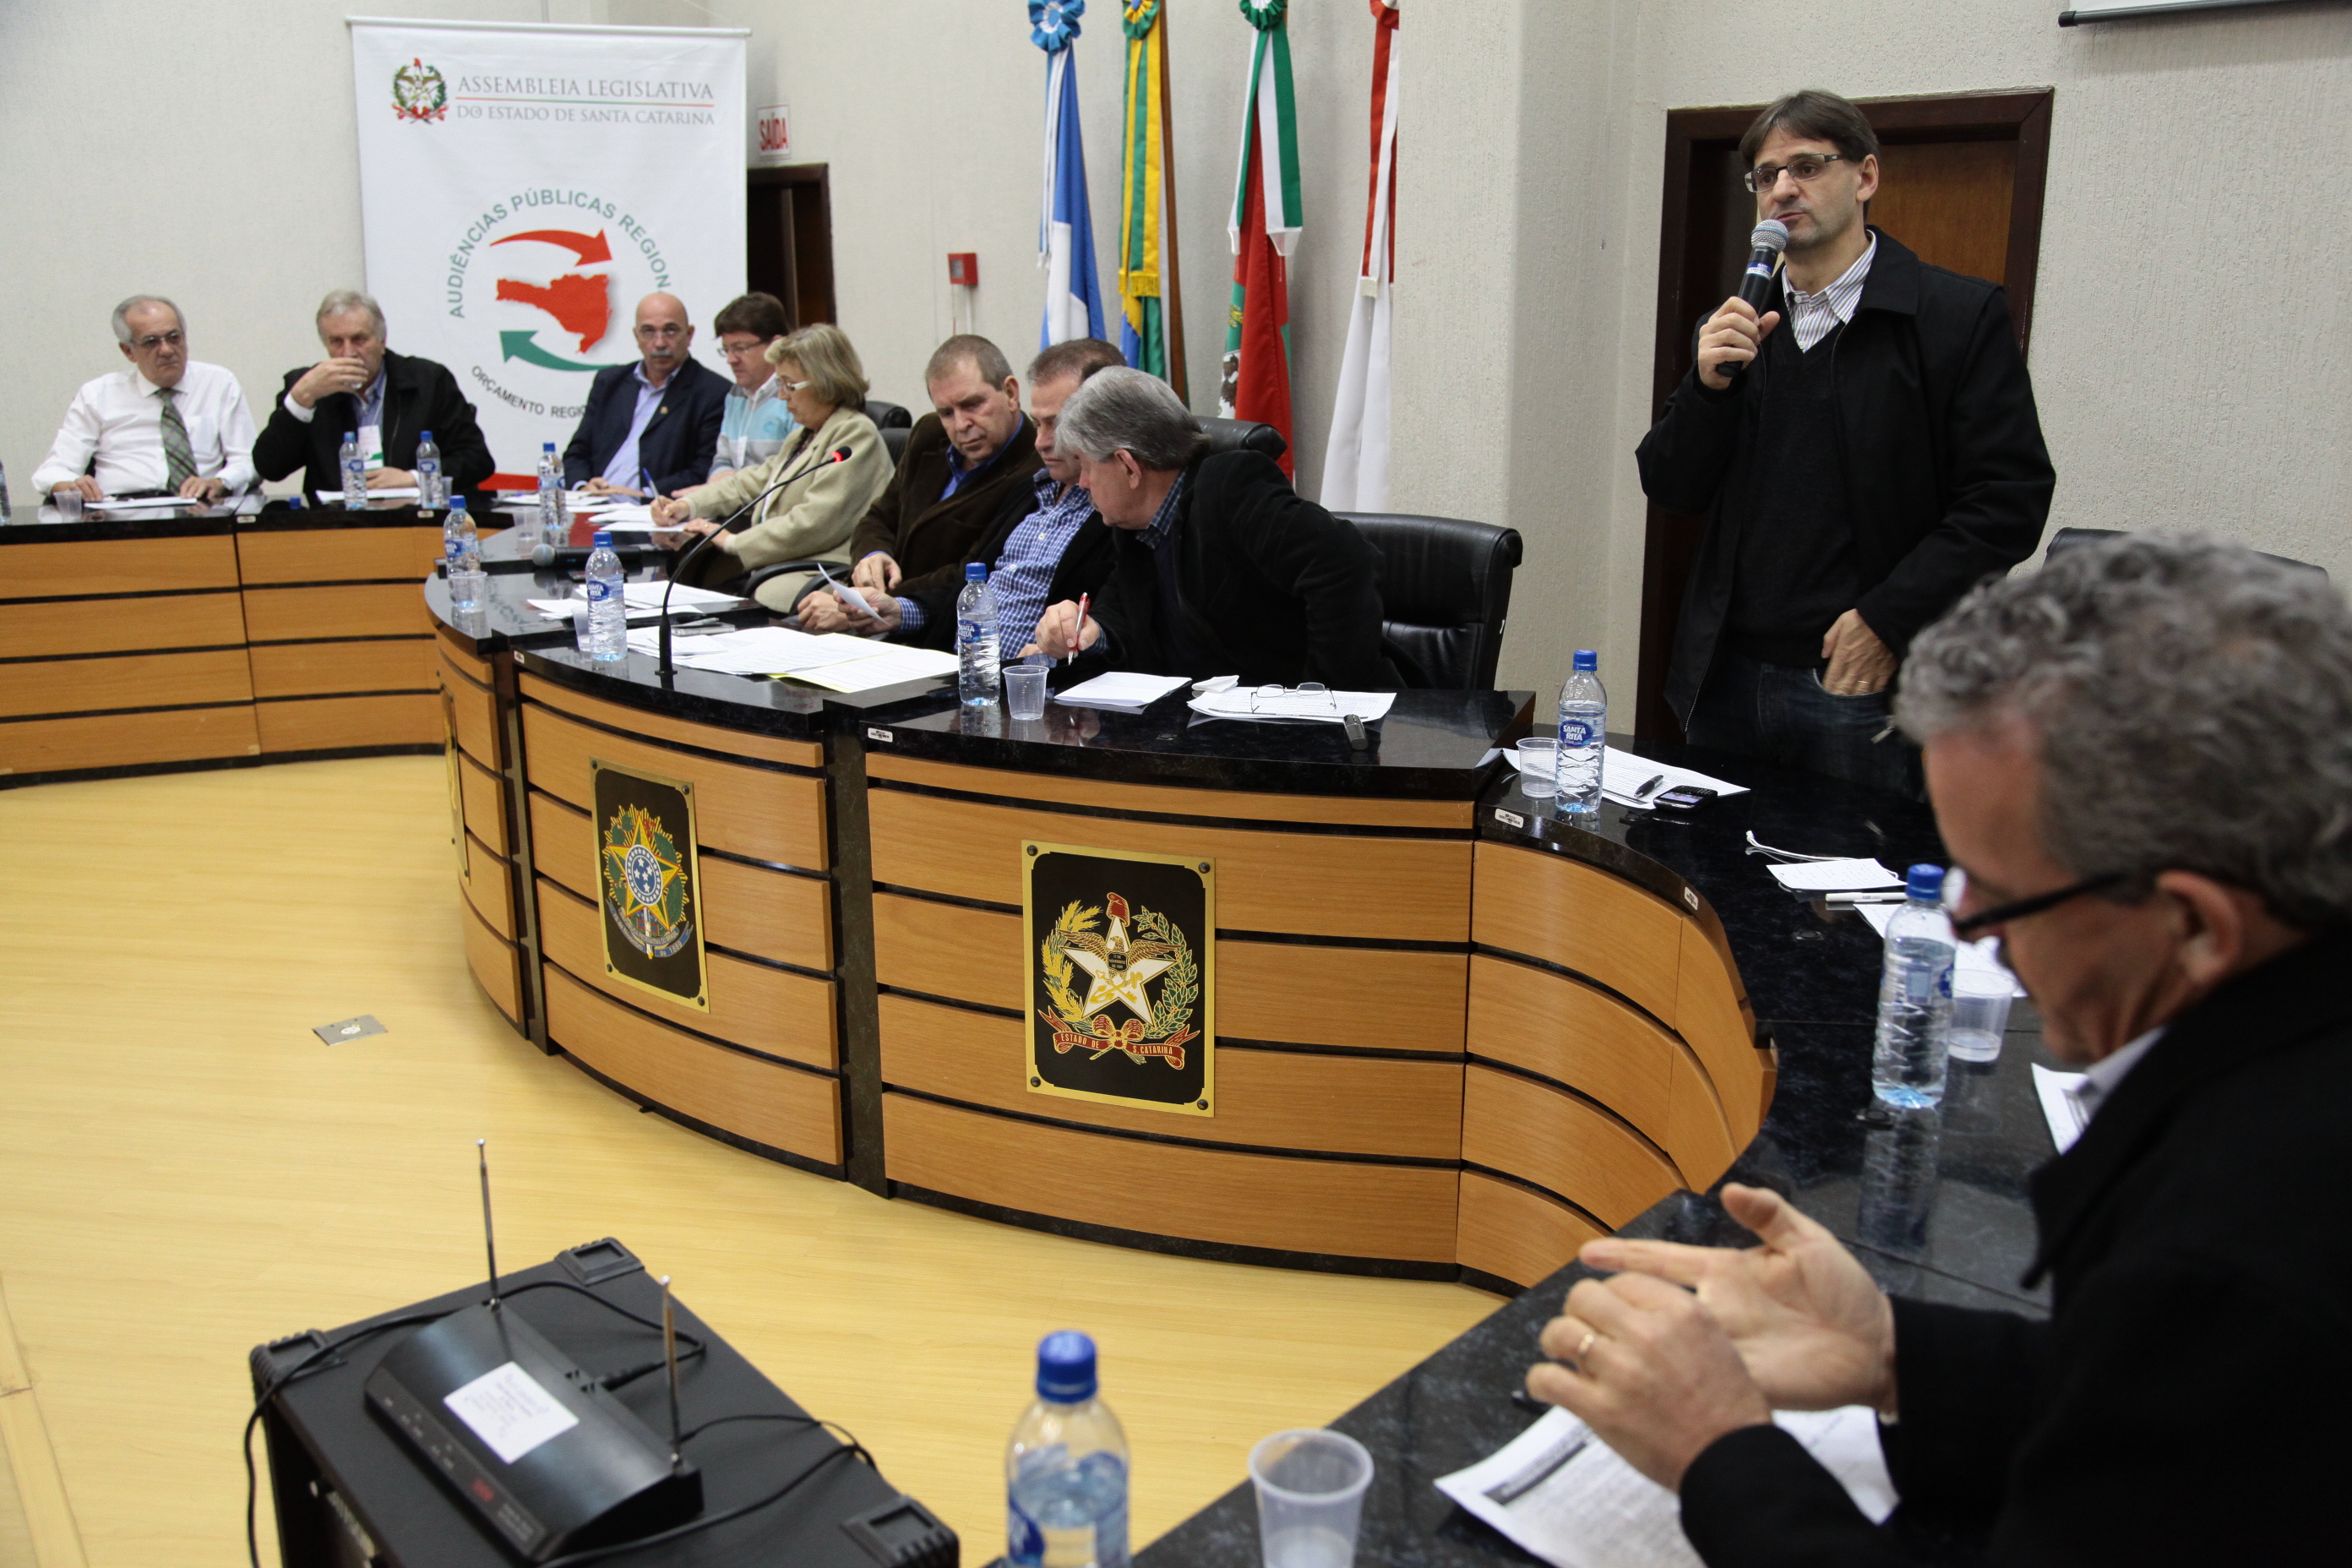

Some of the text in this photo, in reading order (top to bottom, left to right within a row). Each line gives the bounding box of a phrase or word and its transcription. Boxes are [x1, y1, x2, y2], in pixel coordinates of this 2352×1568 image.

[458, 76, 715, 100] ASSEMBLEIA LEGISLATIVA
[457, 105, 715, 126] DO ESTADO DE SANTA CATARINA
[448, 187, 672, 318] AUDIÊNCIAS PÚBLICAS REGION
[471, 365, 545, 416] ORÇAMENTO
[1563, 726, 1586, 734] SANTA
[1565, 732, 1583, 741] RITA
[1060, 1033, 1087, 1045] ESTADO
[1091, 1040, 1100, 1049] DE
